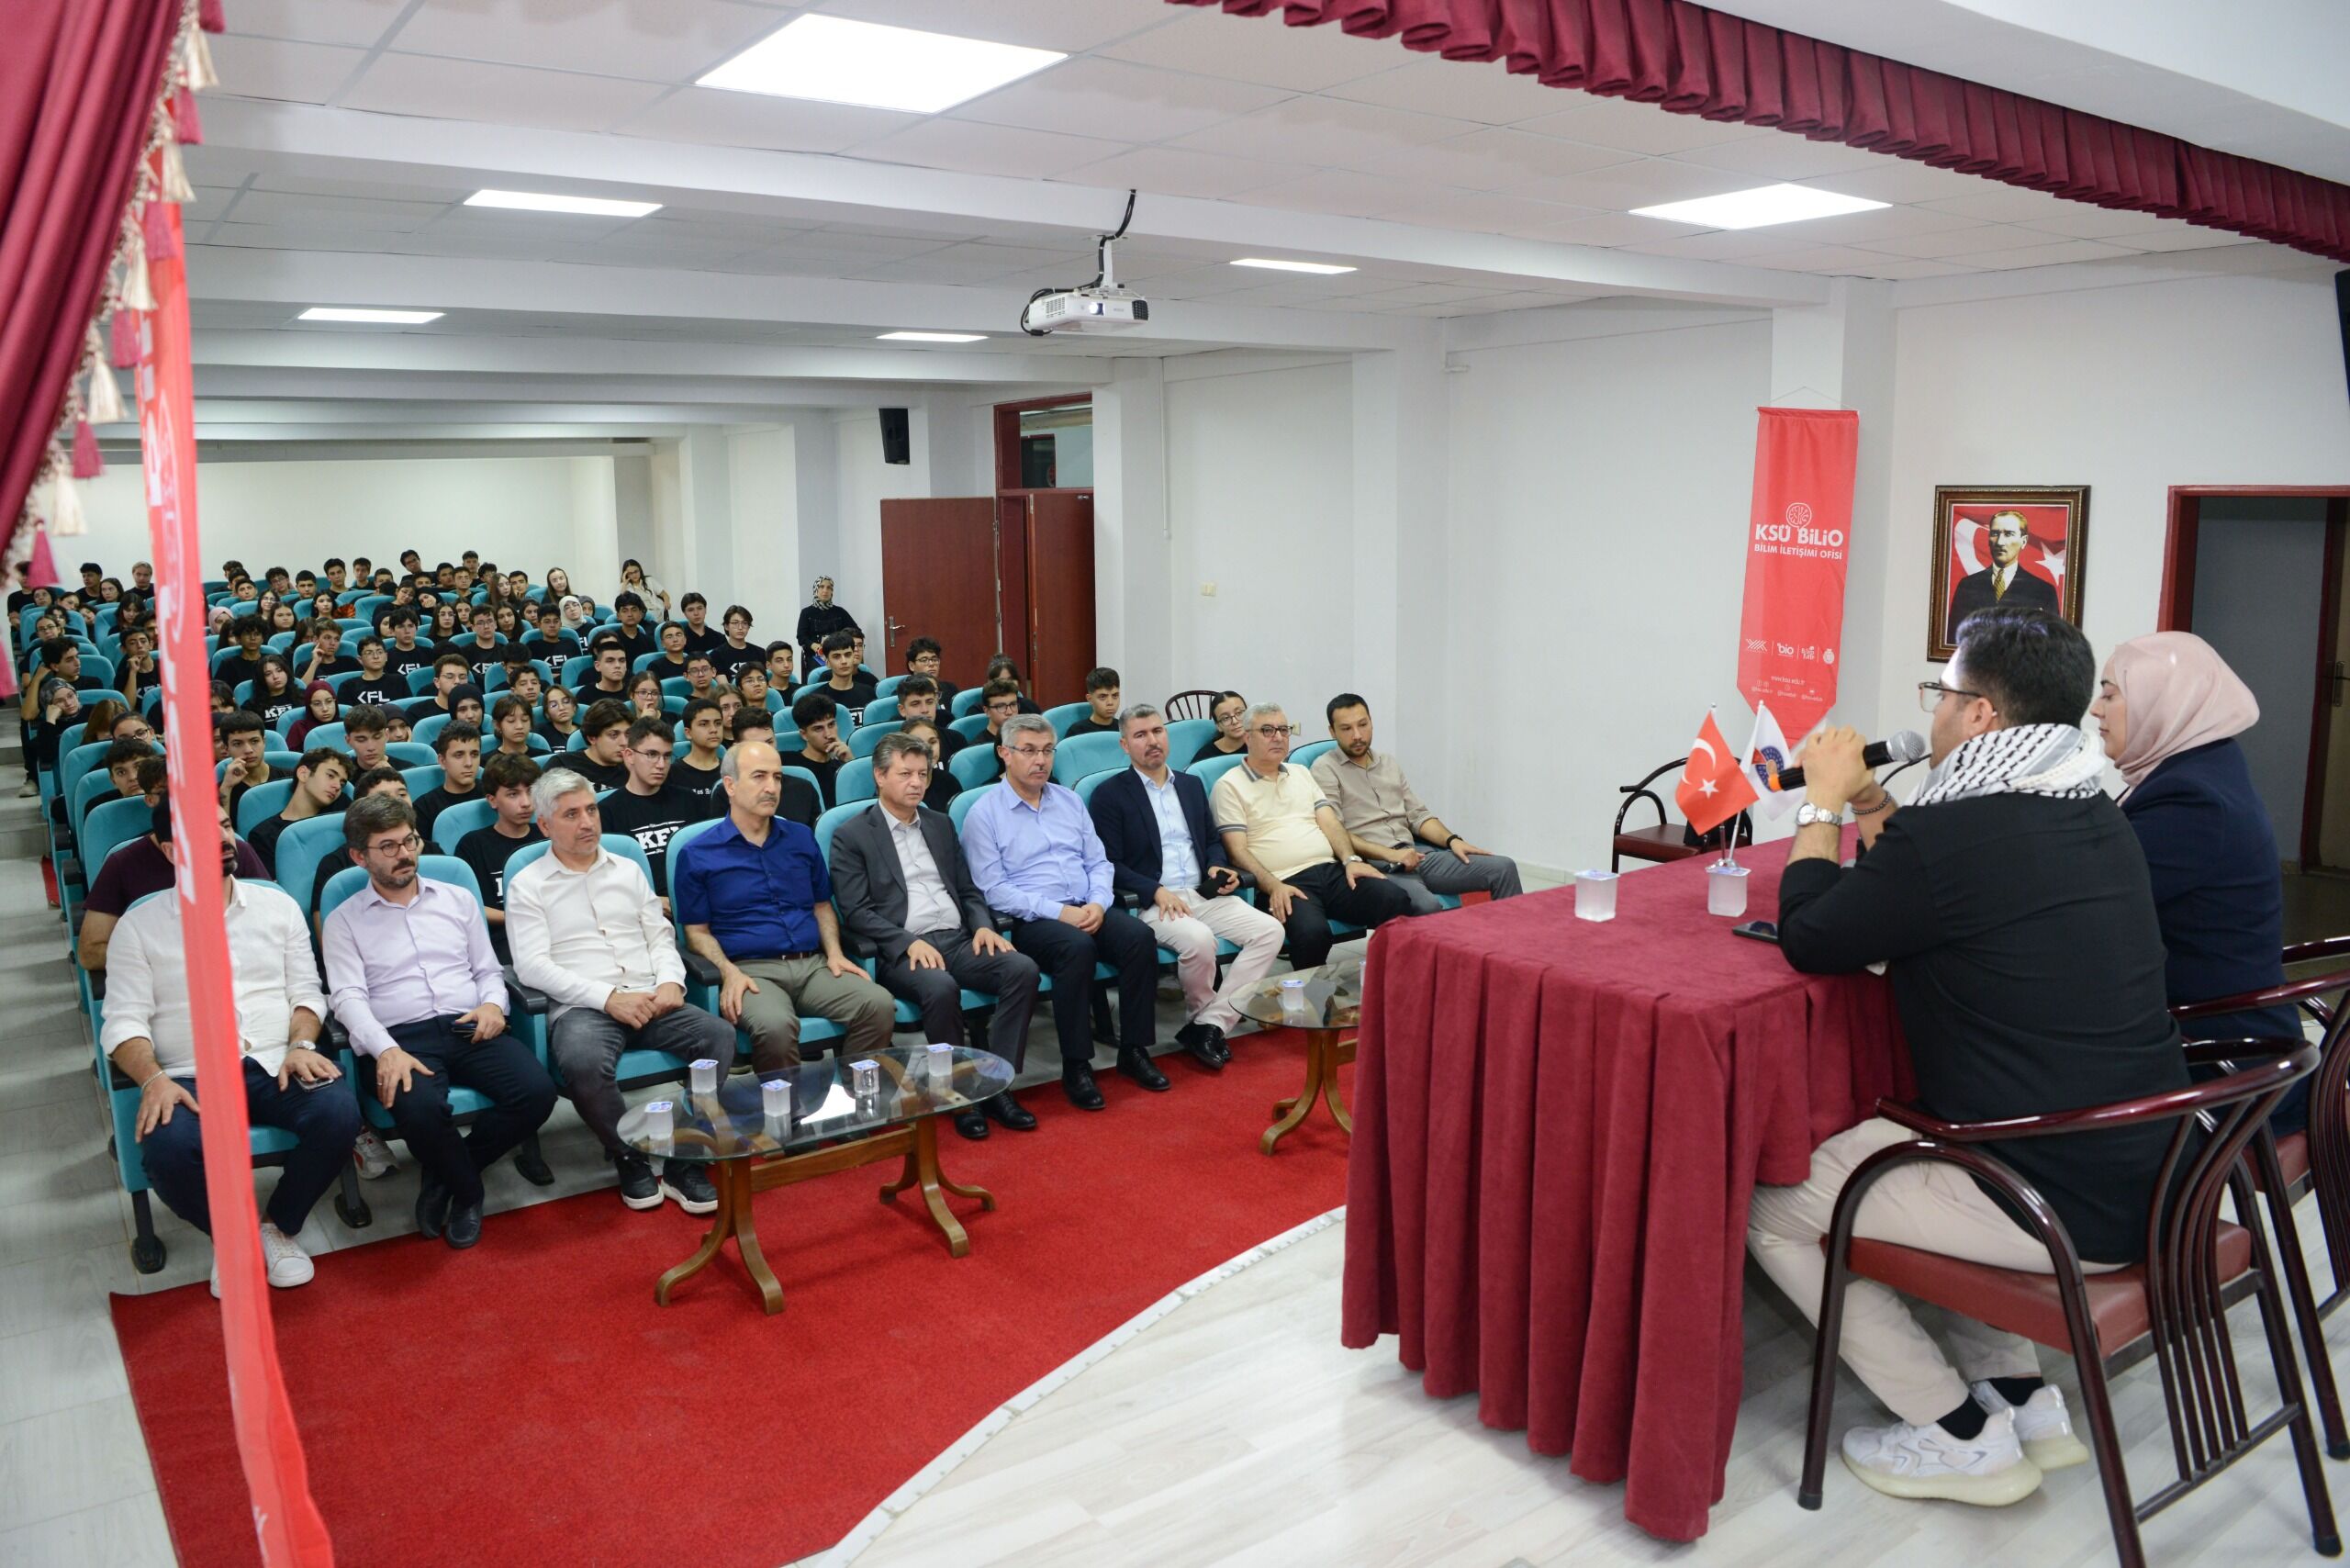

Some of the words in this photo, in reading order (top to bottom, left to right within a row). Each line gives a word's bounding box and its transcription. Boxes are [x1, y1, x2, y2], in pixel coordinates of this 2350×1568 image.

[1755, 523, 1791, 543] KSÜ
[1754, 542, 1778, 554] BİLİM
[1820, 549, 1843, 560] OFİSİ
